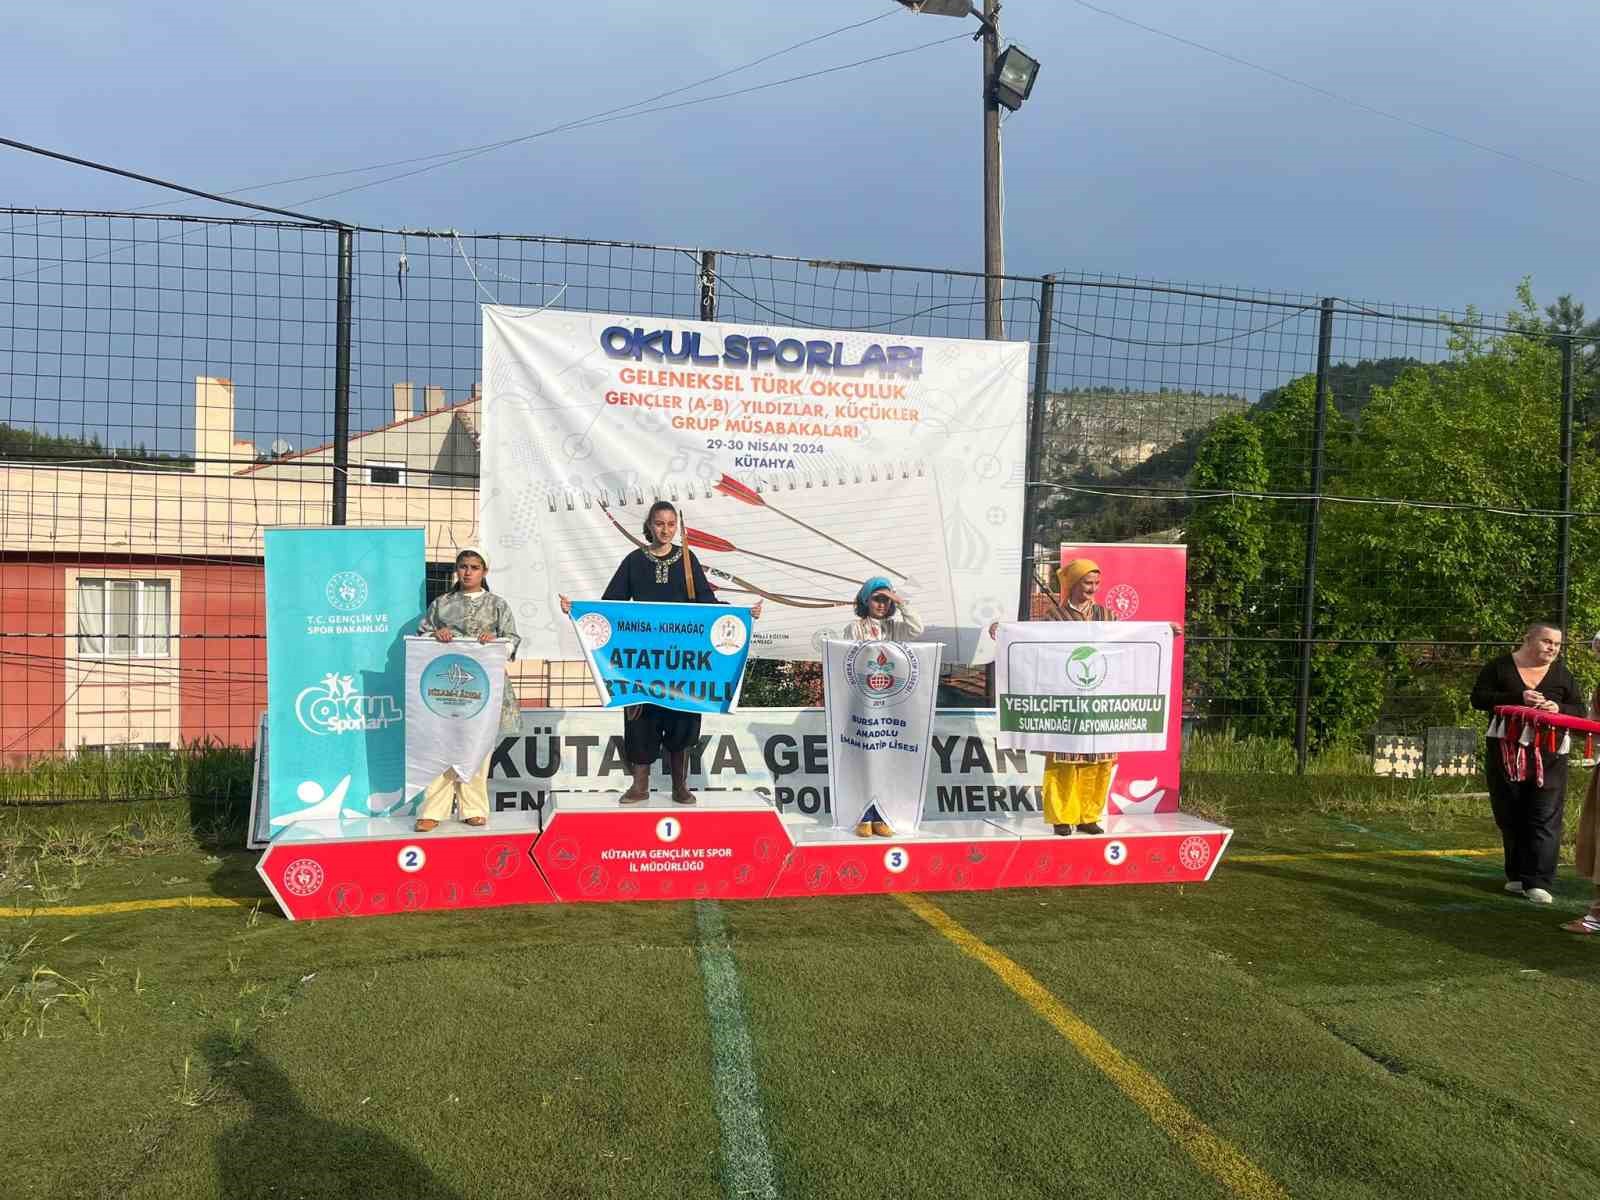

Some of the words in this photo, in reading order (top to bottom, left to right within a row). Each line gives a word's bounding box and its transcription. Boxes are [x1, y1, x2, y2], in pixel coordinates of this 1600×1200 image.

[600, 326, 719, 364] OKUL
[722, 334, 923, 378] SPORLARI
[619, 368, 744, 392] GELENEKSEL
[750, 373, 804, 395] TÜRK
[809, 380, 906, 401] OKÇULUK
[605, 391, 682, 410] GENÇLER
[740, 400, 829, 419] YILDIZLAR,
[835, 402, 919, 422] KÜÇÜKLER
[672, 415, 719, 431] GRUP
[725, 416, 858, 437] MÜSABAKALARI
[707, 439, 743, 450] 29-30
[748, 439, 788, 452] NİSAN
[793, 443, 824, 454] 2024
[735, 455, 795, 469] KÜTAHYA
[328, 615, 372, 624] GENÇLİK
[375, 614, 388, 622] VE
[307, 626, 334, 634] SPOR
[336, 624, 388, 633] BAKANLIĞI
[609, 645, 712, 671] ATATÜRK
[310, 696, 402, 725] OKUL
[1005, 696, 1089, 713] YEŞİLÇİFTLİK
[1092, 697, 1162, 712] ORTAOKULU
[852, 715, 879, 726] BURSA
[881, 717, 907, 727] TOBB
[1019, 716, 1071, 731] SULTANDAĞI
[1079, 716, 1148, 732] AFYONKARAHİSAR
[856, 729, 898, 738] ANADOLU
[487, 727, 748, 778] KÜTAYA
[863, 740, 887, 751] HATİP
[888, 740, 919, 752] LİSESİ
[664, 823, 673, 836] 1
[405, 851, 418, 866] 2
[601, 848, 647, 860] KÜTAHYA
[649, 848, 690, 860] GENÇLİK
[692, 850, 705, 858] VE
[706, 848, 732, 858] SPOR
[891, 853, 902, 867] 3
[1110, 846, 1121, 860] 3
[629, 861, 638, 872] İL
[640, 861, 705, 873] MÜDÜRLÜĞÜ
